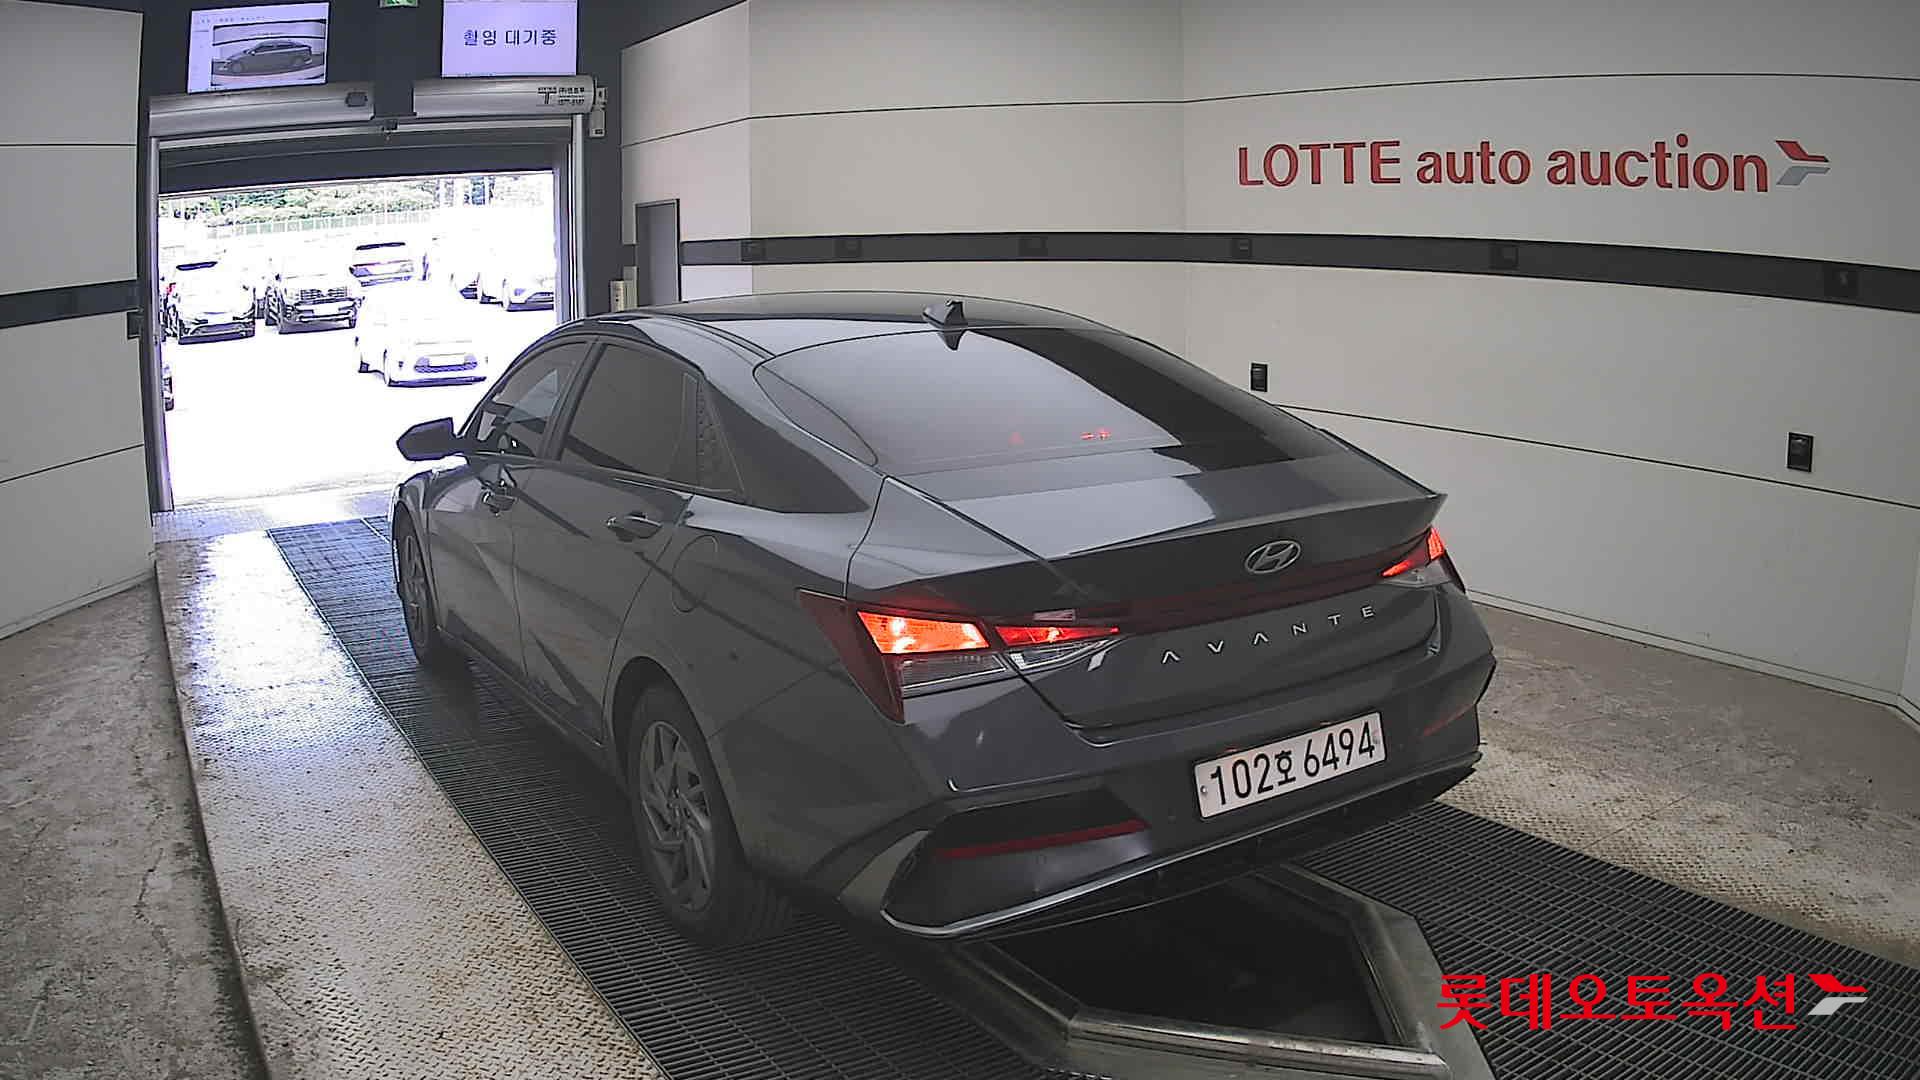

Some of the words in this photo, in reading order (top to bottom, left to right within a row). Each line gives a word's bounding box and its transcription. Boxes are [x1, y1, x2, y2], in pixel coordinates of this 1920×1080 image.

[505, 29, 557, 46] 대기중
[1238, 140, 1401, 187] LOTTE
[1416, 140, 1531, 185] auto
[1546, 133, 1768, 193] auction
[1161, 605, 1375, 664] AVANTE
